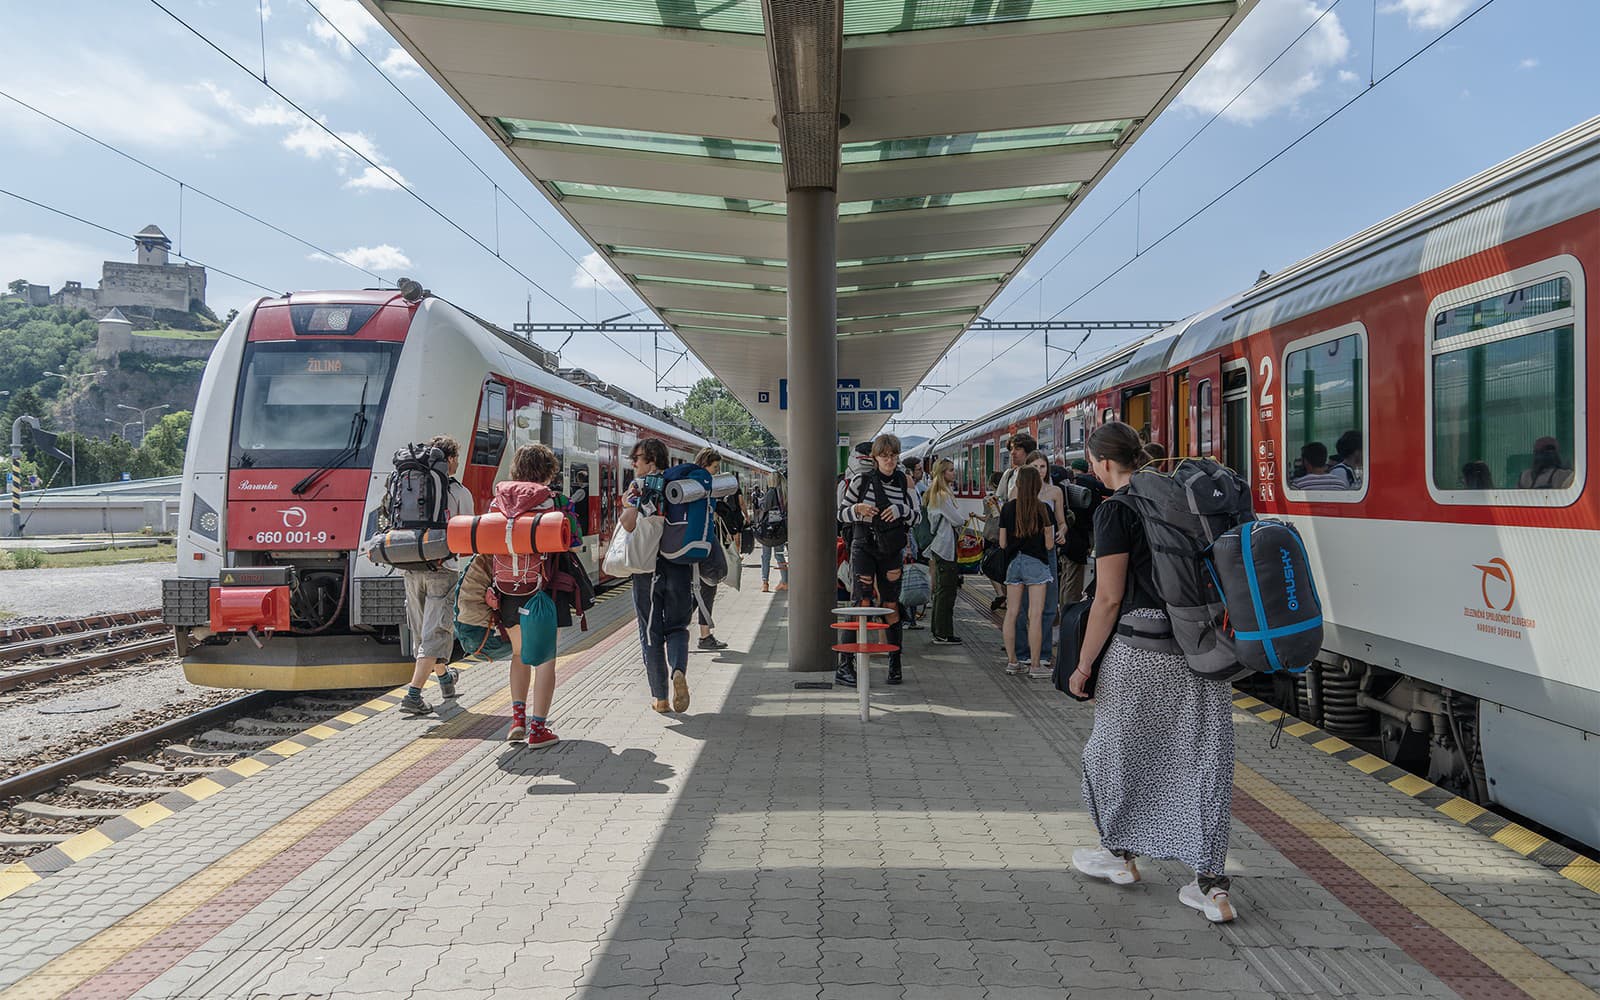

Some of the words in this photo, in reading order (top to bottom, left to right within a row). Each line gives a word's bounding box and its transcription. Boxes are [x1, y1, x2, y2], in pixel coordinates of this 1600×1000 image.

[307, 356, 342, 372] ŽILINA
[1259, 355, 1273, 406] 2
[760, 393, 767, 402] D
[256, 531, 282, 543] 660
[285, 531, 327, 543] 001-9
[1279, 546, 1297, 600] HUSKY
